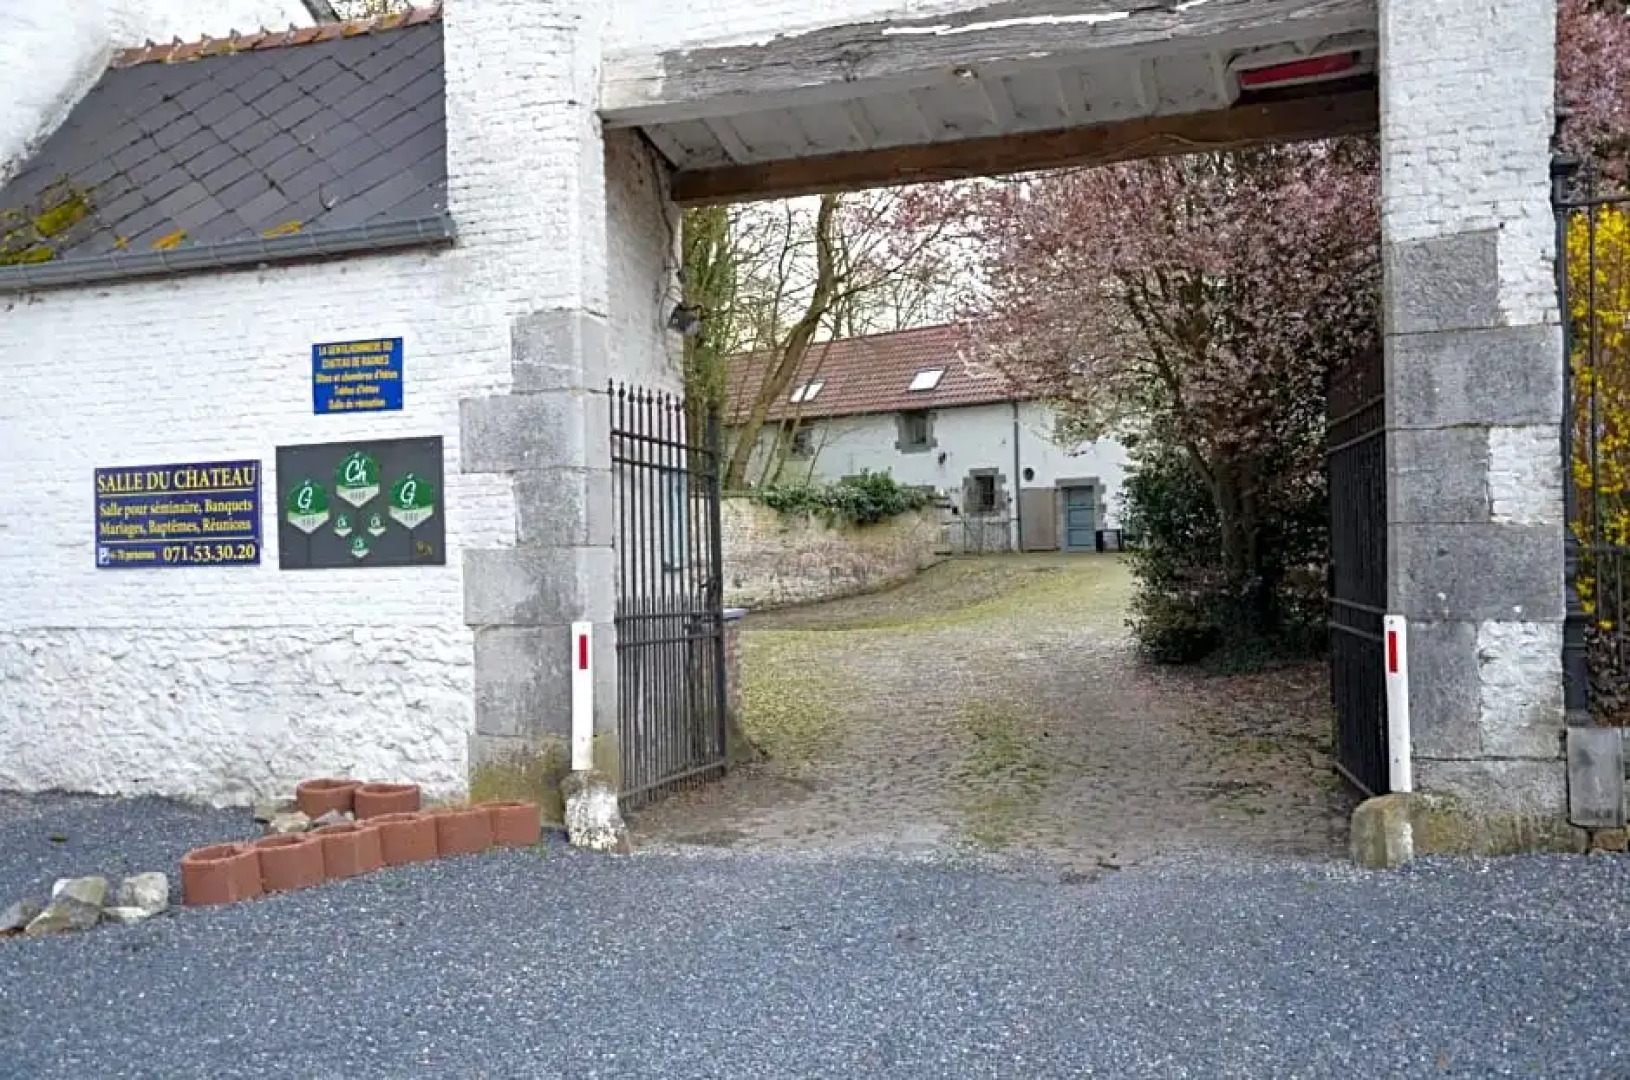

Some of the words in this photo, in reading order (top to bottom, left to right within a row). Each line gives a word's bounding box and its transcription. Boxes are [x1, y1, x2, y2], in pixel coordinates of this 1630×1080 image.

[98, 471, 144, 492] SALLE
[146, 470, 171, 491] DU
[174, 466, 256, 488] CHATEAU
[100, 501, 122, 516] Salle
[124, 504, 148, 520] pour
[204, 498, 253, 516] Banquets
[100, 521, 148, 539] Mariages,
[202, 516, 252, 532] Réunions
[162, 544, 256, 562] 071.53.30.20
